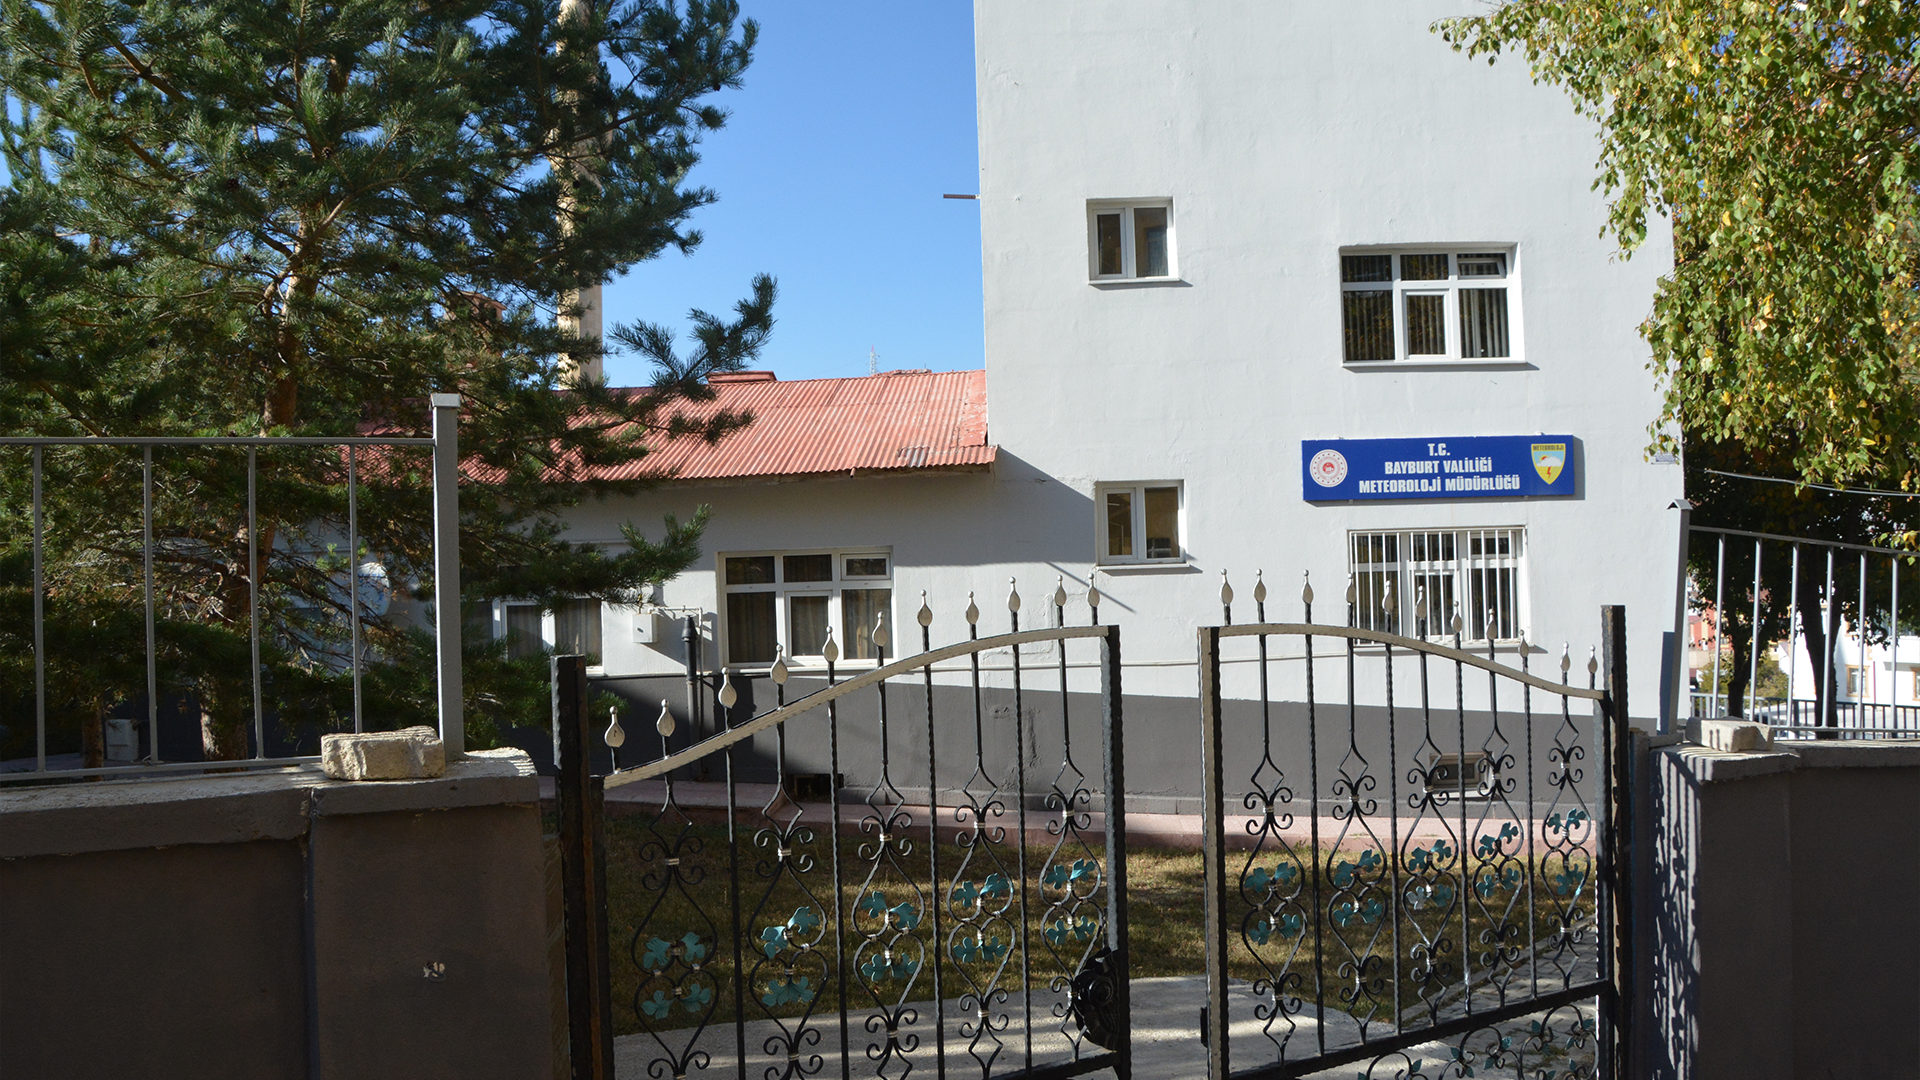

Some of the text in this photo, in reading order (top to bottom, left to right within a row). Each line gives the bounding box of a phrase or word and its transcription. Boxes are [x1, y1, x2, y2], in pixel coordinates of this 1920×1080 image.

[1428, 443, 1450, 456] T.C.
[1384, 457, 1492, 475] BAYBURT VALİLİĞİ
[1359, 475, 1520, 493] METEOROLOJİ MÜDÜRLÜĞÜ
